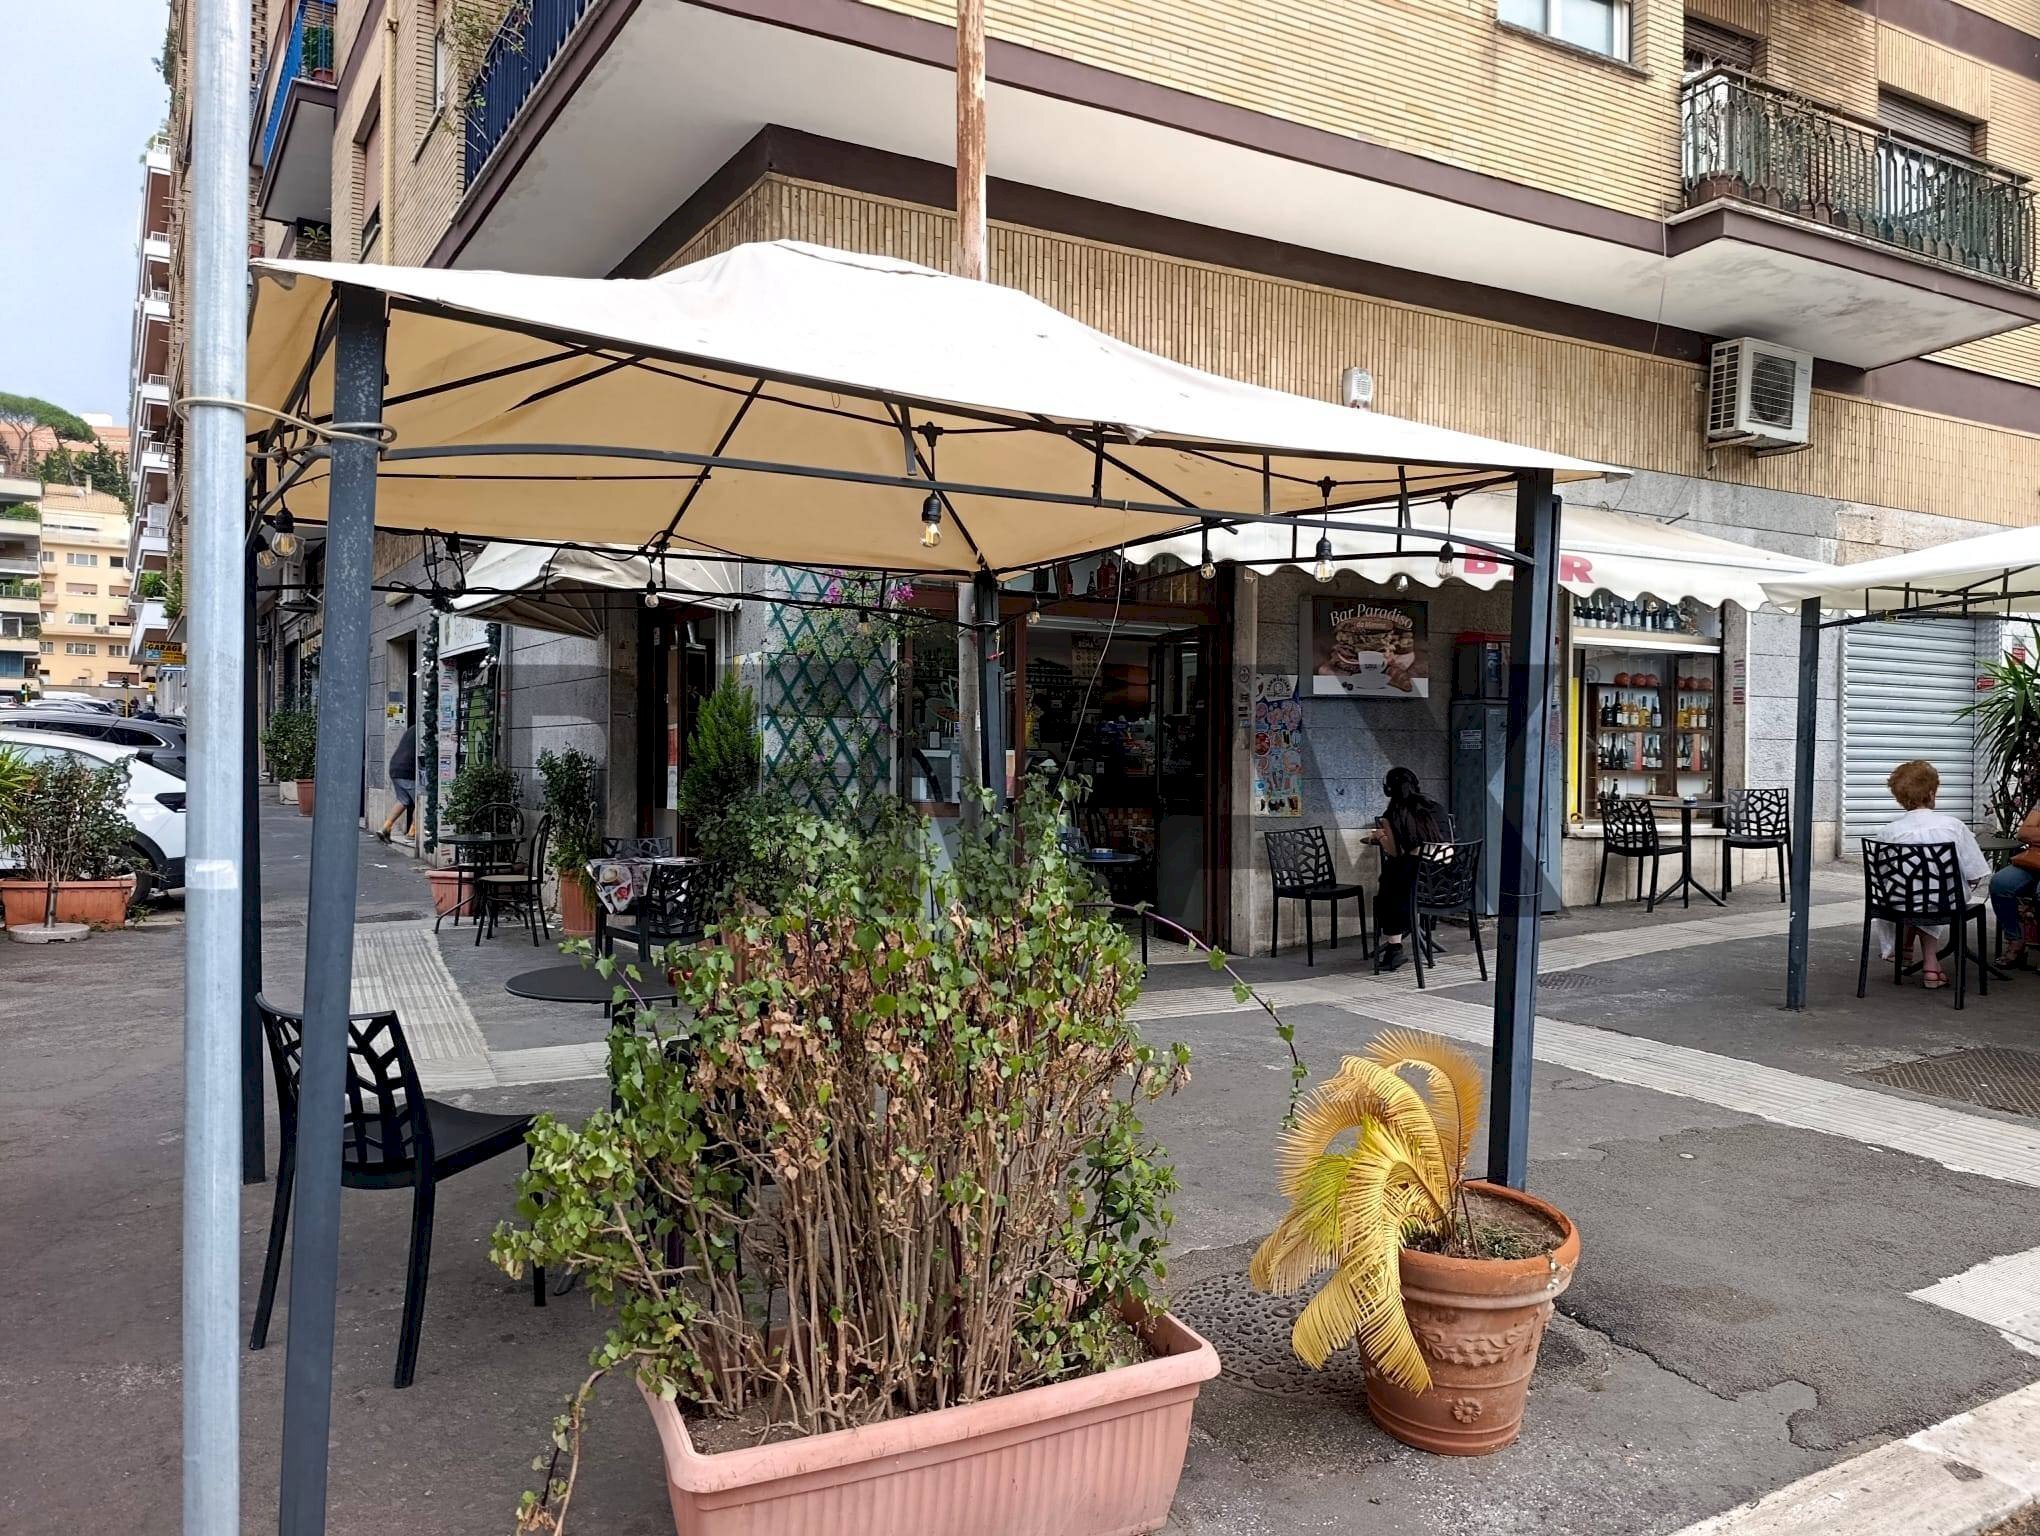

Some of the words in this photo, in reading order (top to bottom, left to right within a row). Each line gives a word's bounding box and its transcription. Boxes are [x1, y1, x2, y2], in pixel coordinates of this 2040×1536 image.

[1464, 543, 1595, 583] BR
[1330, 608, 1354, 627] Bar
[1357, 603, 1414, 629] Paradiso
